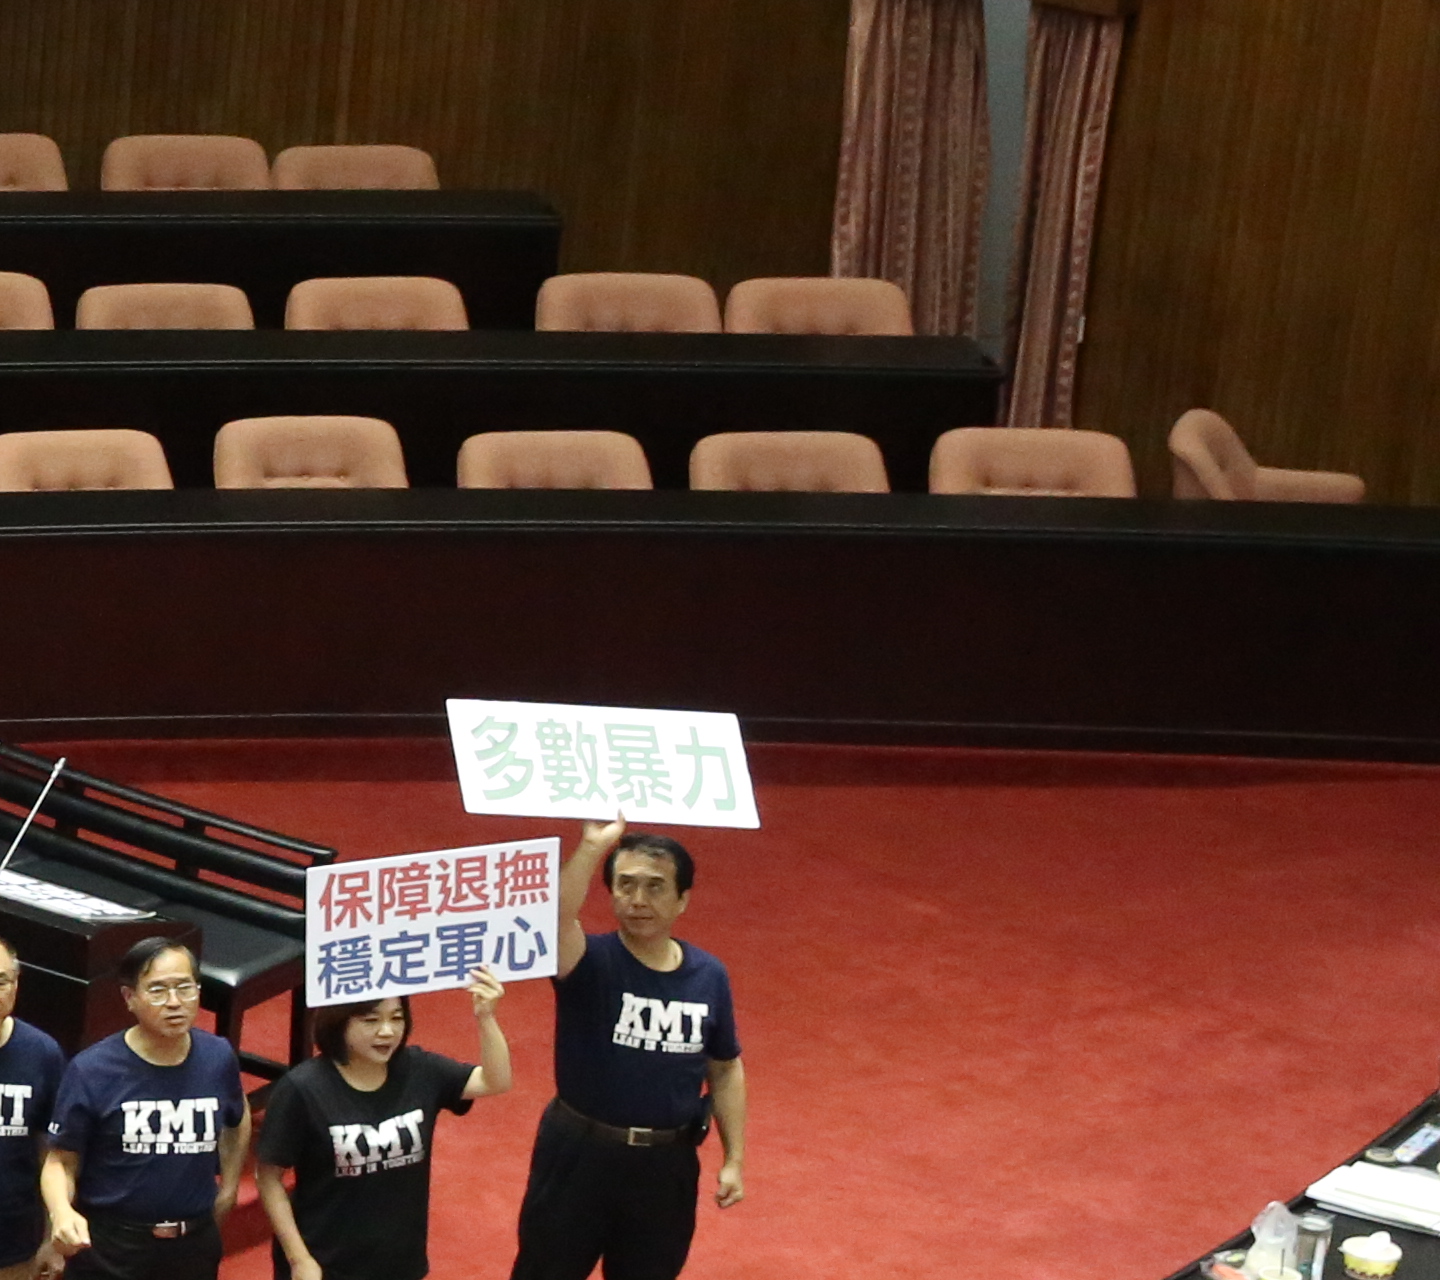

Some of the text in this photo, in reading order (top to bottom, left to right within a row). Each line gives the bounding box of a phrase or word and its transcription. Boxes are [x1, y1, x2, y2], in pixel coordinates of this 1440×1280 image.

[469, 714, 737, 812] 多數暴力
[317, 849, 551, 932] 保障退撫
[317, 915, 548, 999] 穩定軍心
[615, 993, 709, 1044] KMT
[121, 1097, 219, 1143] KMT
[328, 1109, 425, 1169] KMT
